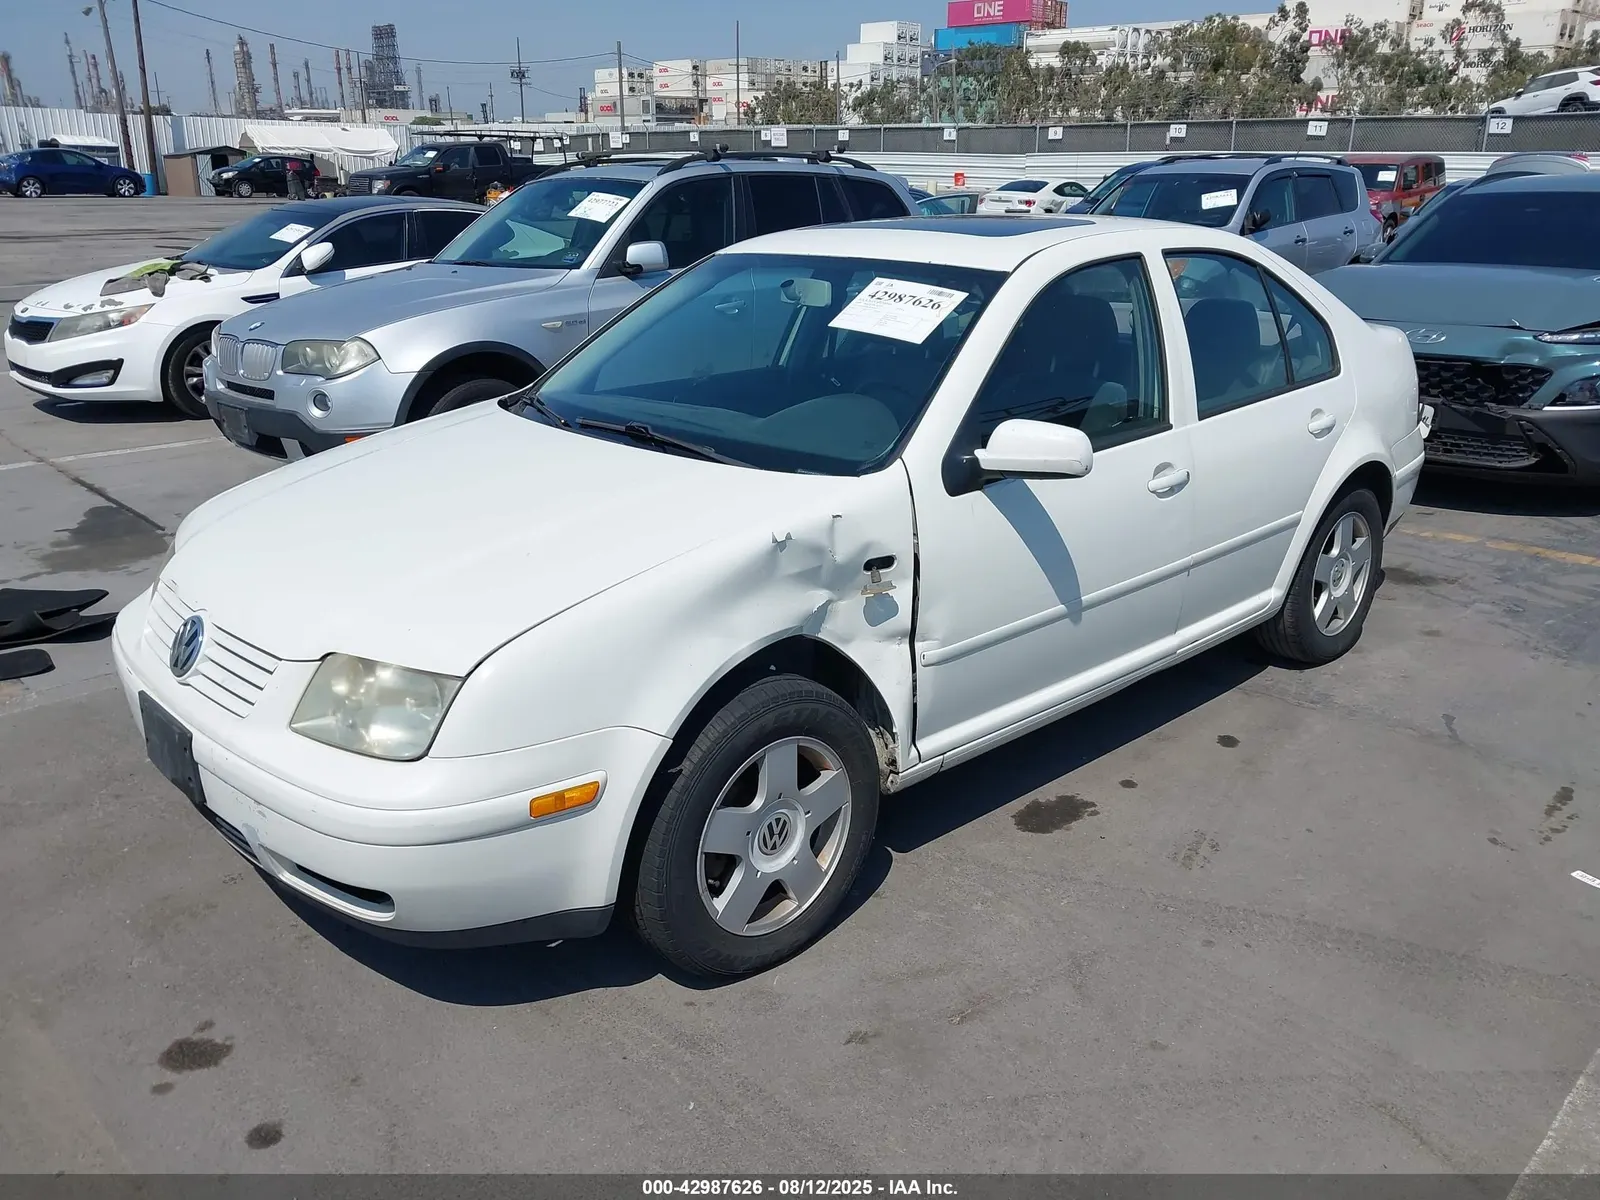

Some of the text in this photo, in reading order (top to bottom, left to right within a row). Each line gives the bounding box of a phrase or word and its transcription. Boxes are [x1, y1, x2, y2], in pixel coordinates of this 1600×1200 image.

[973, 0, 1004, 18] ONE
[1467, 23, 1514, 34] HORIZON
[1313, 124, 1323, 132] 11
[1495, 121, 1507, 130] 12
[868, 290, 942, 310] 42987626
